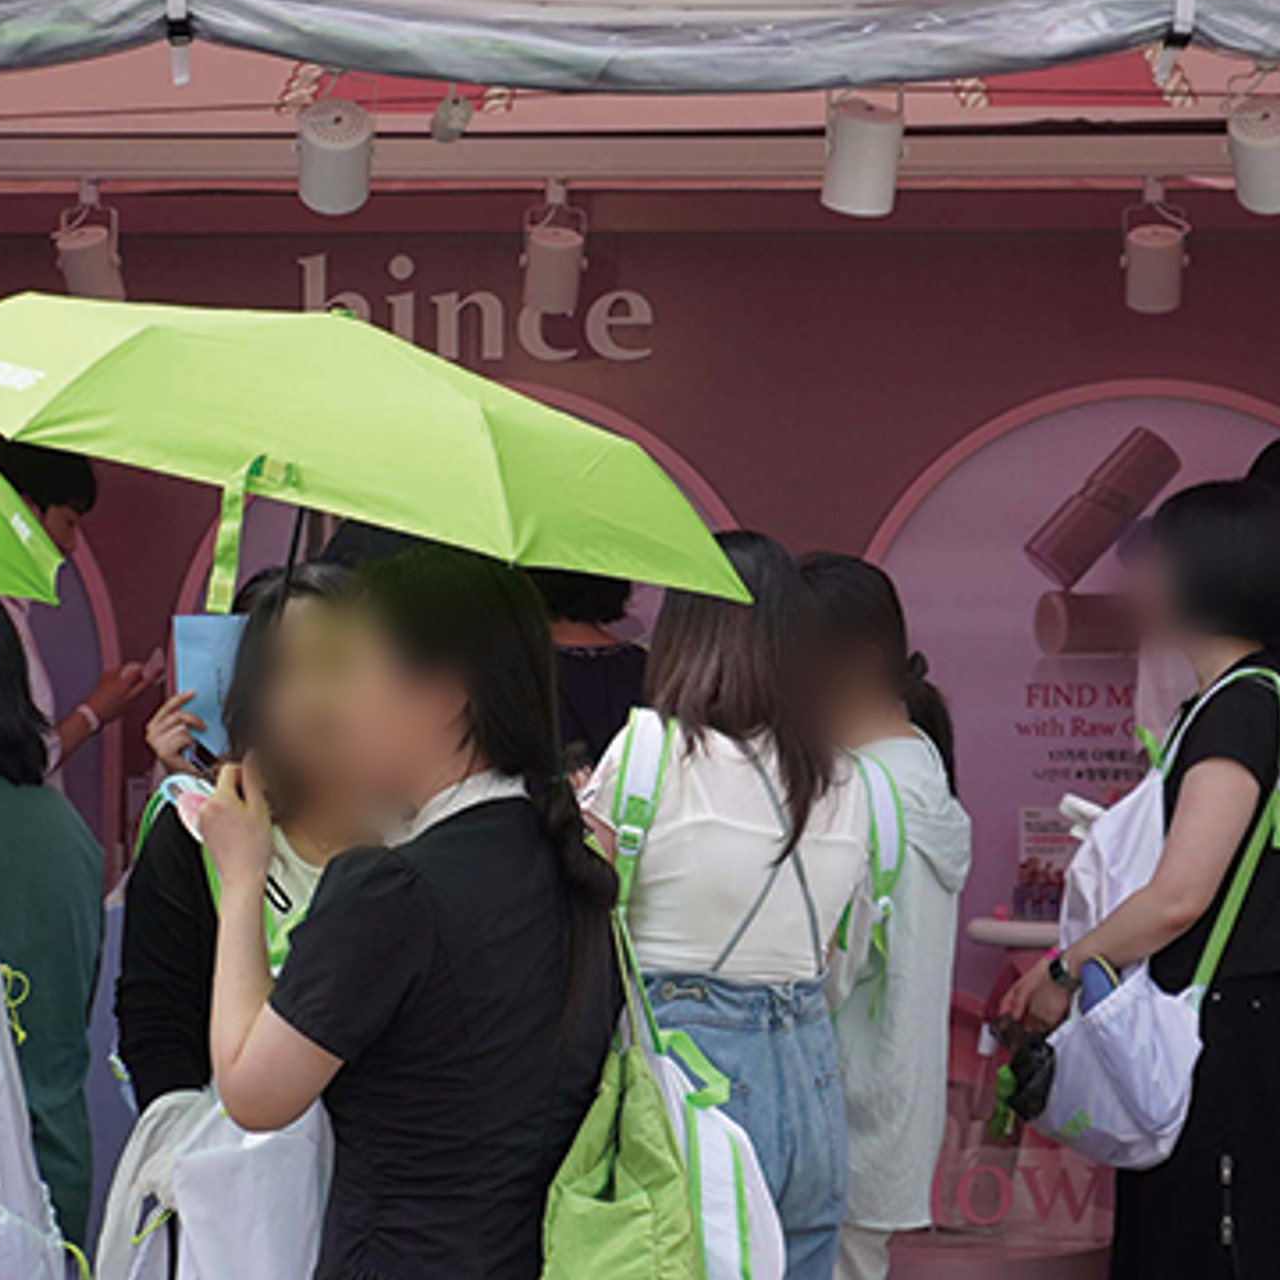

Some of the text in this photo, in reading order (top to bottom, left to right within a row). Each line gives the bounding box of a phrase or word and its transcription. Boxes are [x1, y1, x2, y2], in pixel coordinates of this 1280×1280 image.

[1026, 683, 1097, 708] FIND
[1014, 716, 1064, 737] with
[1071, 716, 1118, 737] Raw
